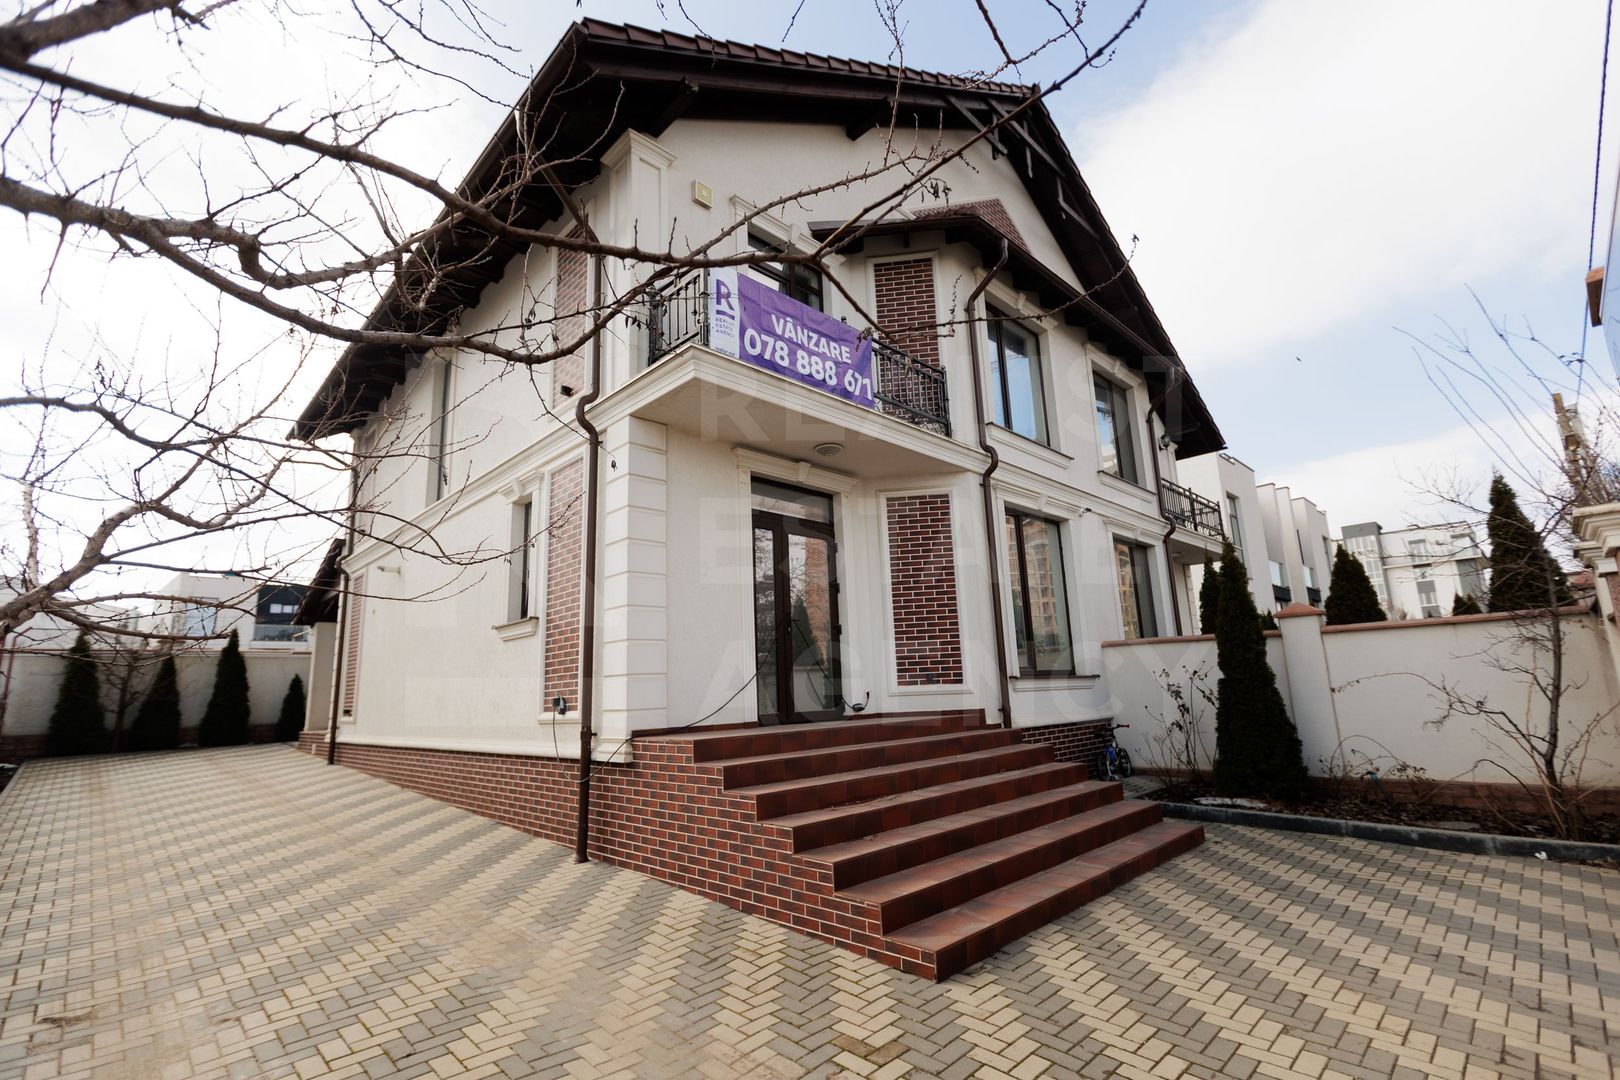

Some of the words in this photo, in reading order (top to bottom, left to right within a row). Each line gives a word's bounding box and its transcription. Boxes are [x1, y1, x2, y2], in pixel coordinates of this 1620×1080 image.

[716, 279, 735, 311] R
[744, 328, 790, 367] 078
[796, 350, 837, 386] 888
[844, 369, 872, 400] 671
[771, 314, 851, 364] VÂNZARE
